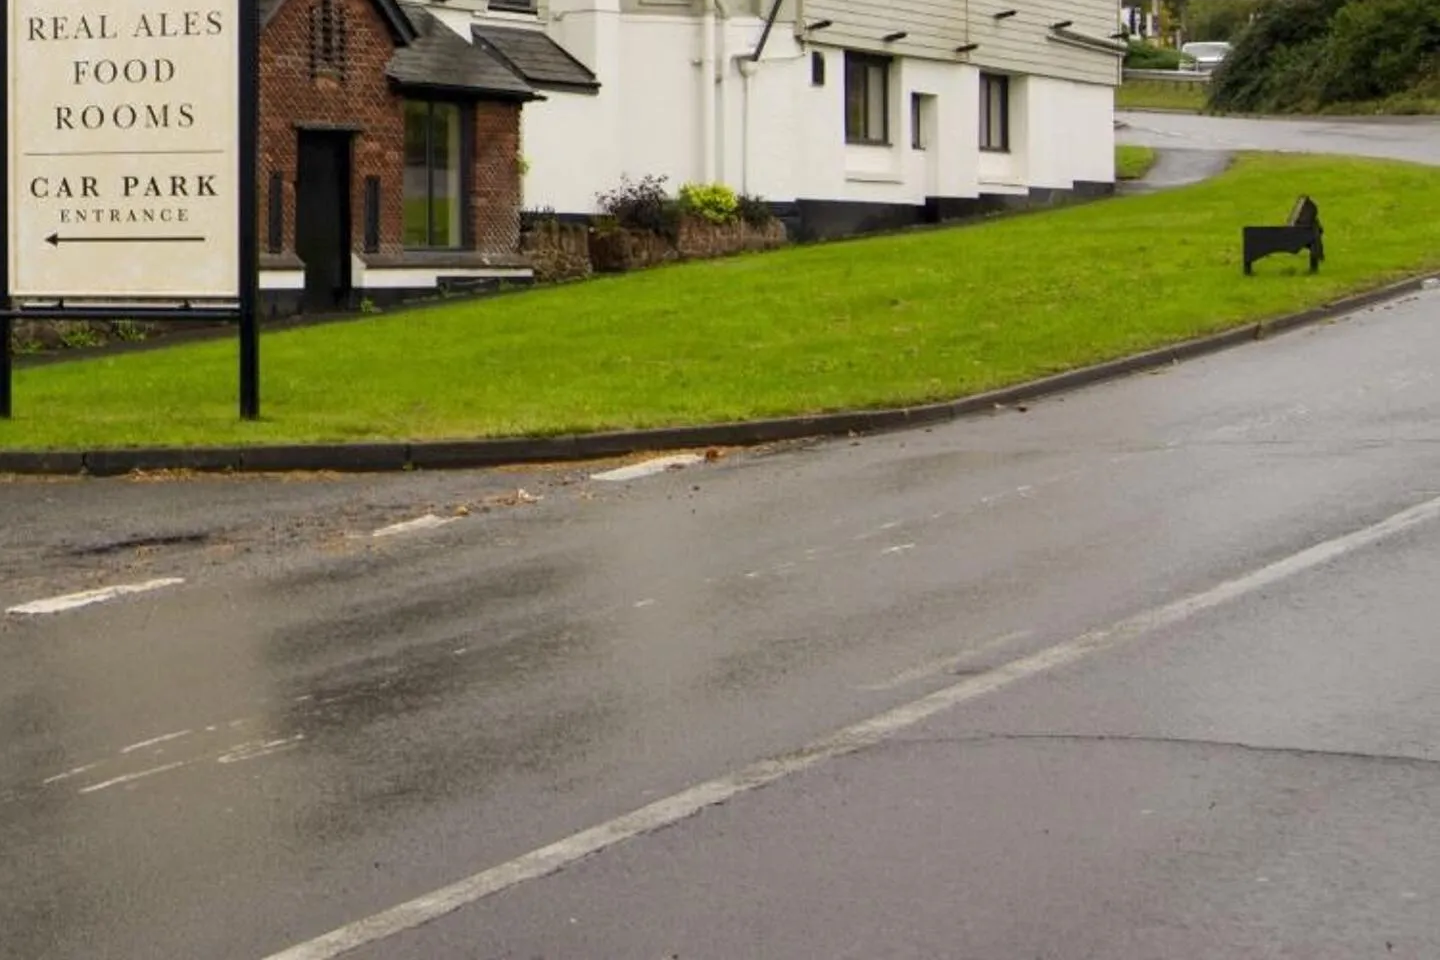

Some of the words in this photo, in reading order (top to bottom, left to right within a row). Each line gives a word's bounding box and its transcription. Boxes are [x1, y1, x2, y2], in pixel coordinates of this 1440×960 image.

[27, 14, 118, 41] REAL
[133, 10, 223, 38] ALES
[72, 58, 176, 85] FOOD
[54, 102, 195, 130] ROOMS
[29, 176, 100, 198] CAR
[121, 175, 219, 197] PARK
[59, 208, 189, 223] ENTRANCE
